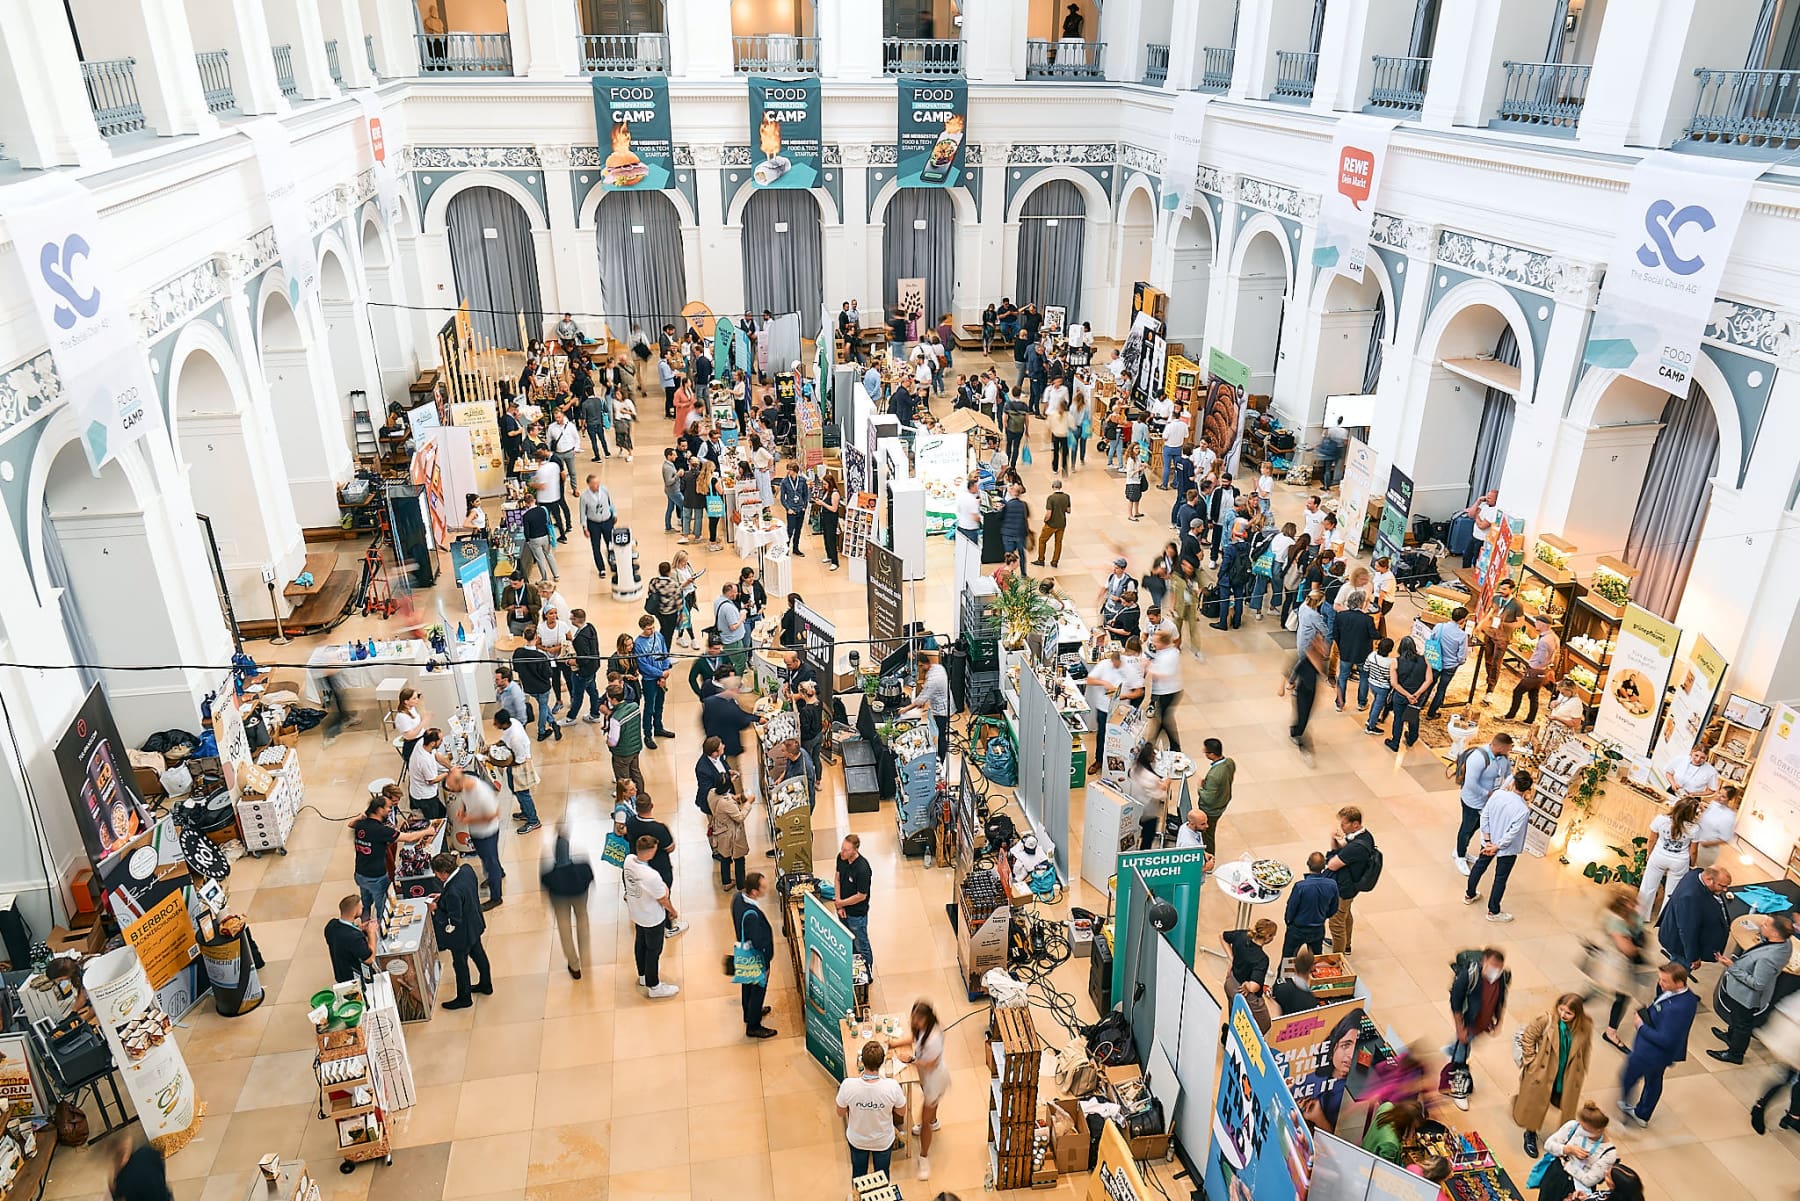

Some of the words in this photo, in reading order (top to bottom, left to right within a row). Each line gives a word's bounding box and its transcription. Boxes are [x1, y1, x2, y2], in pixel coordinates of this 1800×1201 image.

[610, 87, 654, 100] FOOD
[765, 88, 807, 100] FOOD
[914, 89, 954, 101] FOOD
[612, 110, 655, 123] CAMP
[766, 110, 807, 122] CAMP
[913, 111, 953, 122] CAMP
[1343, 157, 1369, 176] REWE
[1341, 173, 1352, 185] Dein
[1351, 176, 1366, 189] Markt
[1349, 262, 1362, 272] CAMP
[1631, 269, 1643, 282] The
[1643, 273, 1664, 287] Social
[1664, 278, 1685, 292] Chain
[1685, 284, 1698, 295] AG
[1662, 346, 1692, 365] FOOD
[1658, 366, 1686, 384] CAMP
[123, 408, 145, 430] CAMP
[207, 443, 214, 451] 5
[228, 732, 242, 762] ROY
[194, 838, 214, 869] ROY
[1122, 855, 1170, 868] LUTSCH
[1171, 853, 1201, 864] DICH
[130, 898, 180, 943] BIERBROT
[1275, 1040, 1331, 1065] SHAKE
[1295, 1054, 1330, 1073] TILL
[1293, 1083, 1316, 1099] KE
[1320, 1078, 1338, 1093] IT
